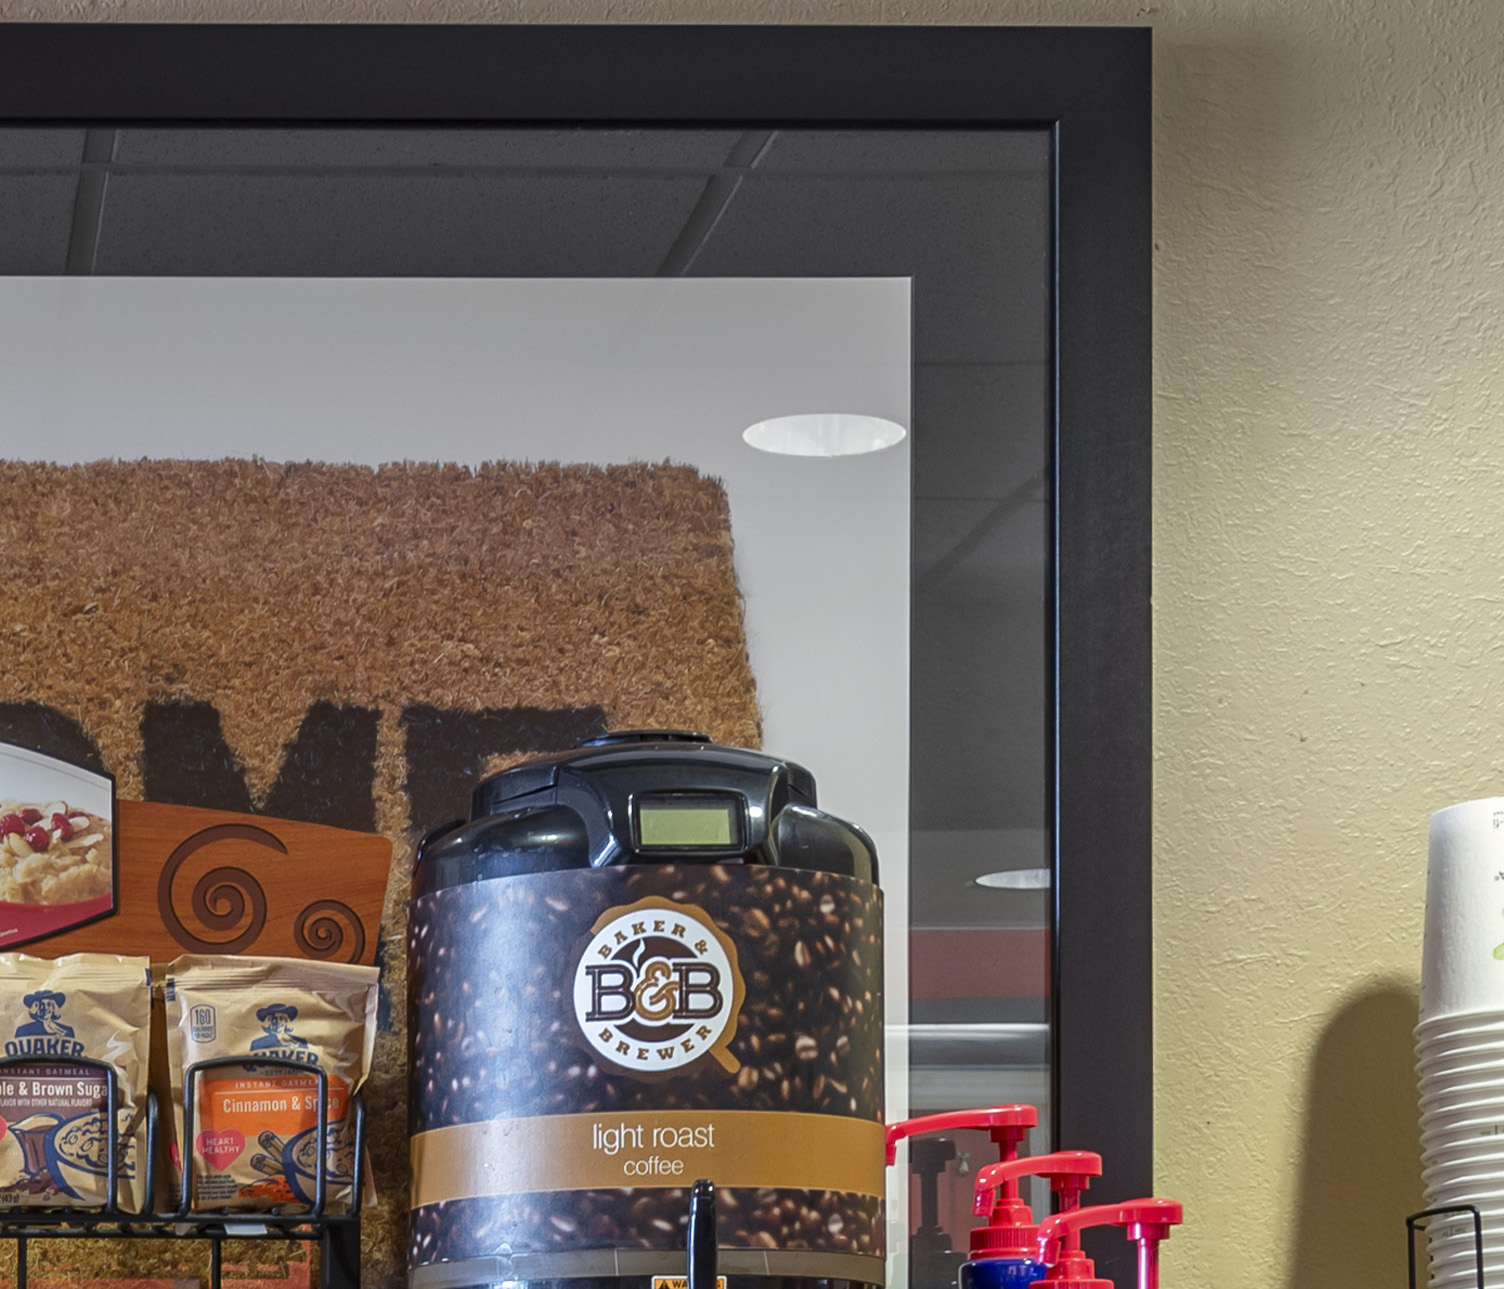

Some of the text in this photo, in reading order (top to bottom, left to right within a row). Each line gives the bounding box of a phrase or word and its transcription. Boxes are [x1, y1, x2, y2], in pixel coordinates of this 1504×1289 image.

[598, 920, 709, 959] BAKER &
[585, 961, 723, 1022] B&B
[195, 1008, 211, 1025] 160
[4, 1038, 85, 1057] QUAKER
[598, 1025, 713, 1062] BREWER
[18, 1082, 28, 1096] &
[32, 1082, 73, 1096] Brown
[77, 1081, 108, 1099] Suga
[206, 1137, 234, 1146] HEART
[592, 1123, 715, 1155] light roast
[202, 1145, 240, 1154] HEALTHY
[623, 1156, 684, 1177] coffee
